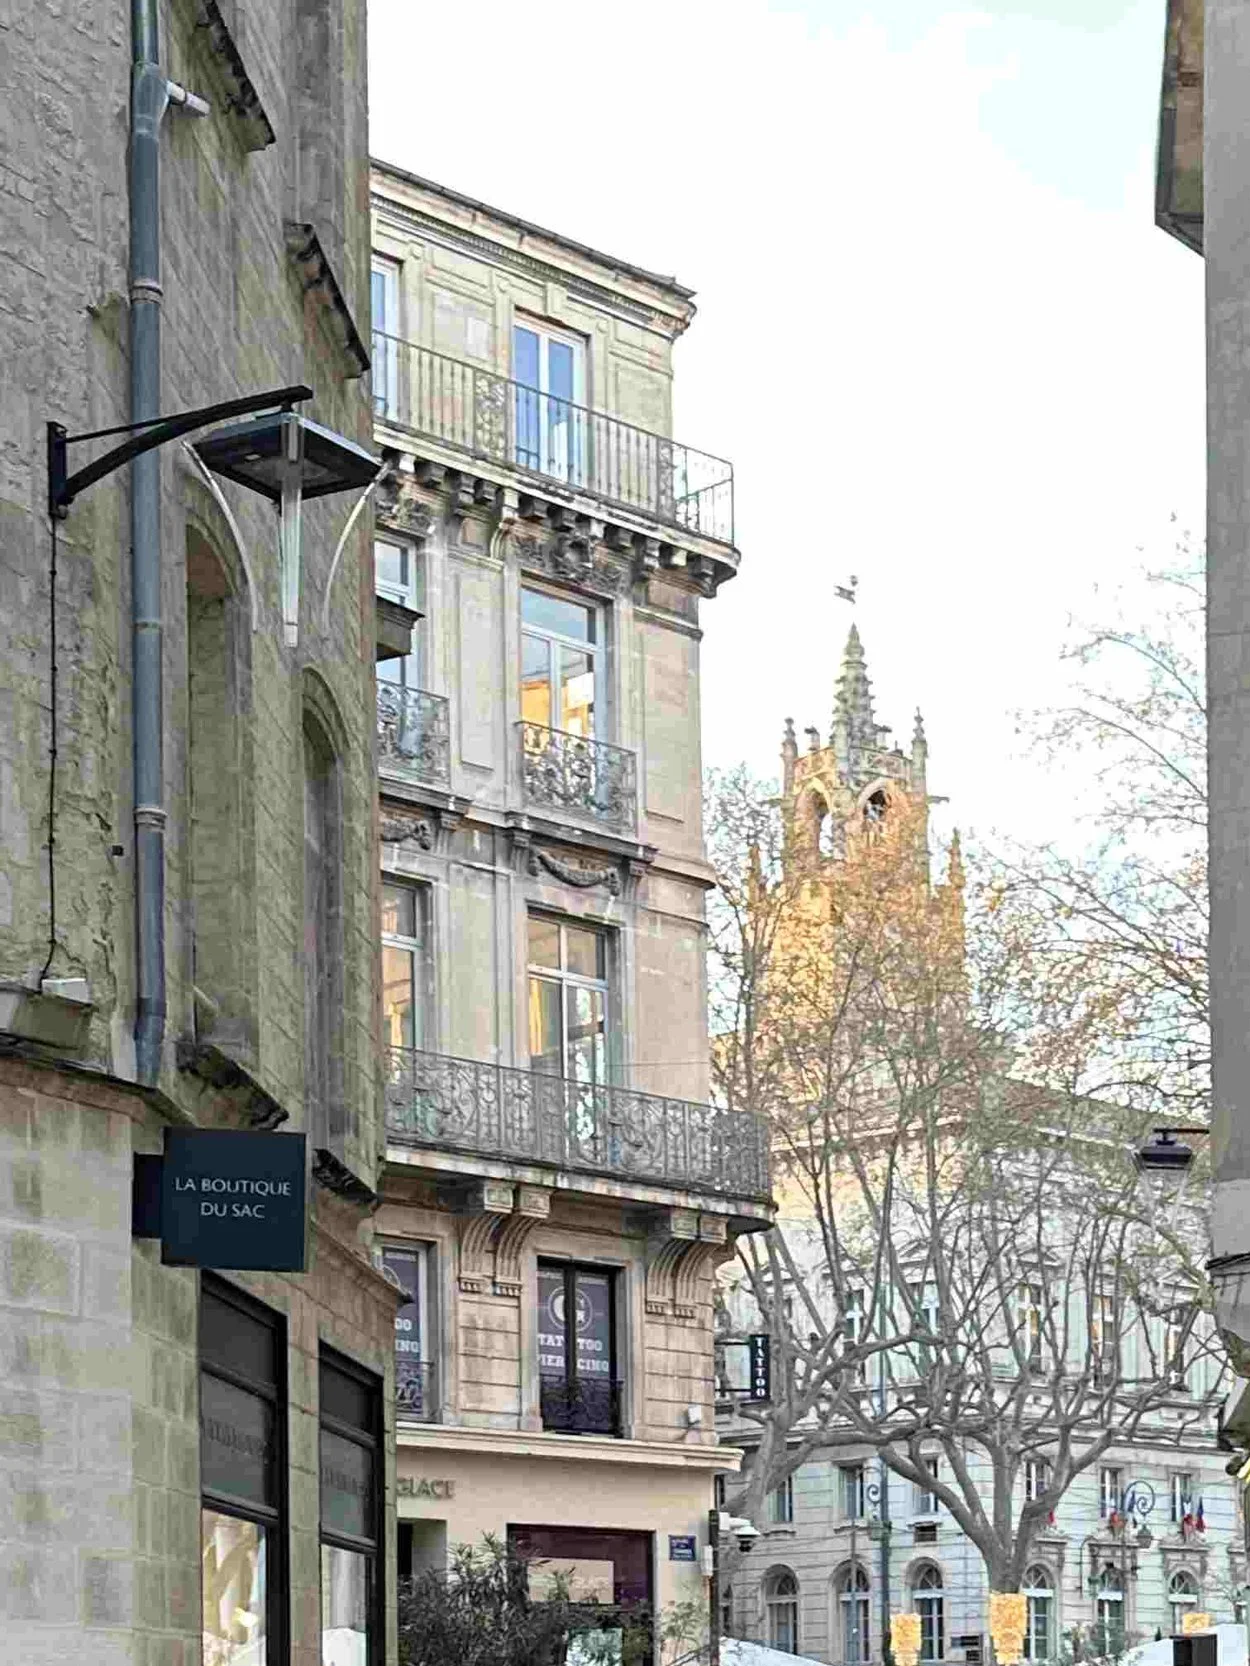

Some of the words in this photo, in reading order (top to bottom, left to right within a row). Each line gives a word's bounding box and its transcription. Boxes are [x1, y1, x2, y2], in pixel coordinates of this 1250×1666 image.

[175, 1177, 196, 1191] LA
[201, 1178, 291, 1196] BOUTIQUE
[200, 1202, 227, 1217] DU
[231, 1203, 265, 1218] SAC
[755, 1336, 766, 1397] TATTOO
